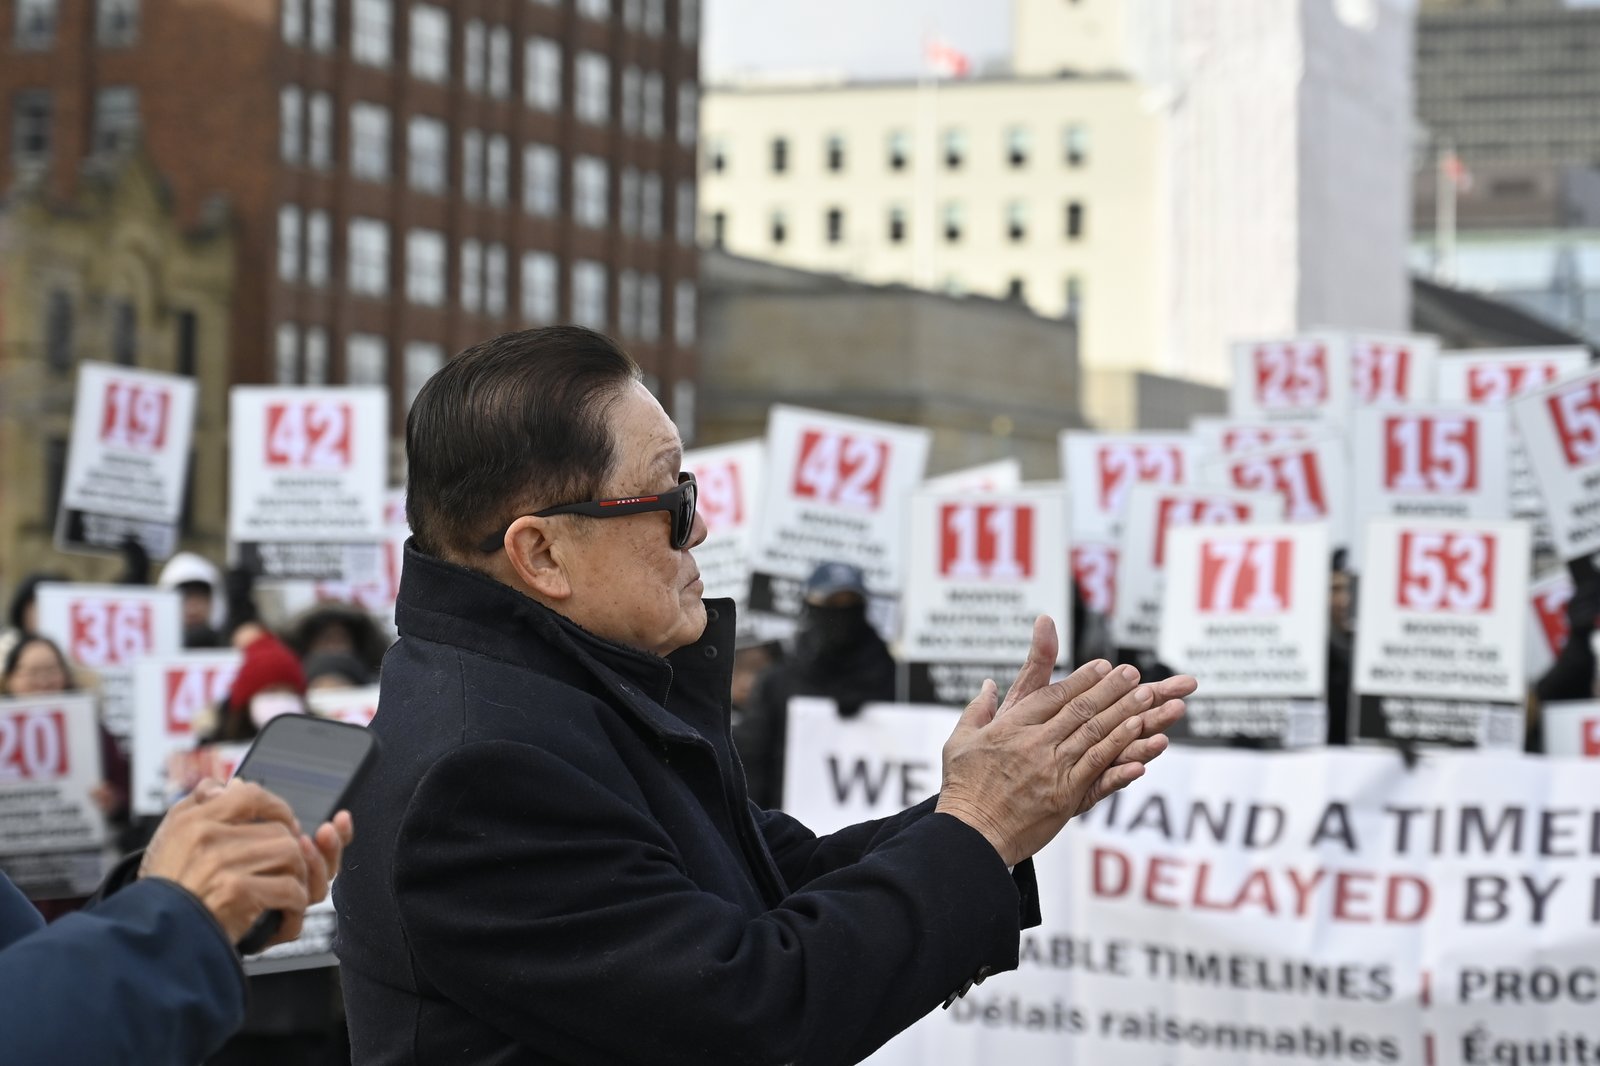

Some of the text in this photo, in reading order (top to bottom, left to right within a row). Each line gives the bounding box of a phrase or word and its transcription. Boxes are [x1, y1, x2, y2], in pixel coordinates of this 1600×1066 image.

[1255, 342, 1328, 405] 25
[100, 380, 172, 450] 19
[265, 402, 353, 466] 42
[1548, 378, 1600, 465] 5
[792, 427, 892, 511] 42
[1384, 416, 1479, 492] 15
[938, 503, 1035, 578] 11
[1200, 537, 1294, 614] 71
[1398, 530, 1497, 614] 53
[70, 602, 155, 667] 36
[0, 710, 69, 780] 20
[828, 756, 931, 806] WE
[1309, 799, 1358, 853] A
[1384, 804, 1600, 858] TIME
[1091, 845, 1434, 926] DELAYED
[1463, 874, 1563, 926] BY
[1144, 942, 1394, 1002] TIMELINES
[1458, 966, 1598, 1006] PROC
[1101, 1006, 1399, 1063] raisonnables
[1462, 1021, 1600, 1066] Équit
